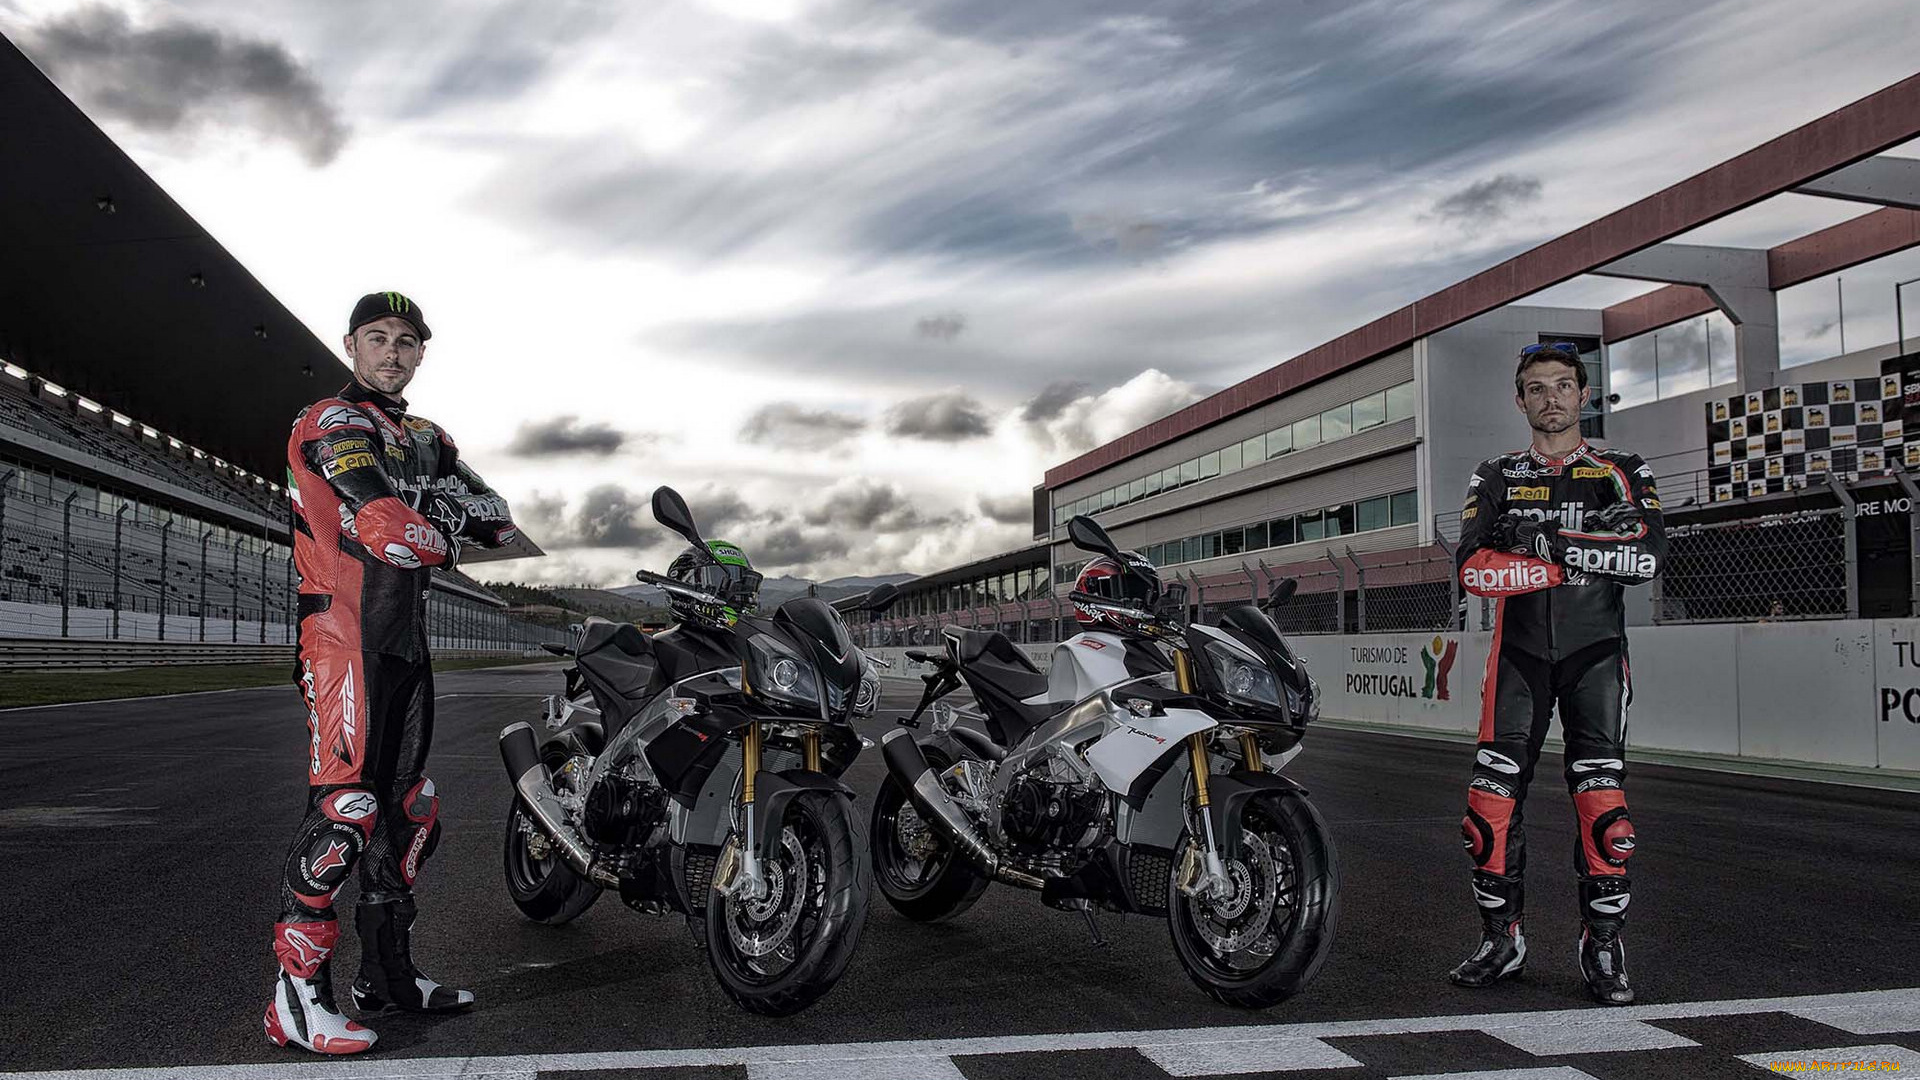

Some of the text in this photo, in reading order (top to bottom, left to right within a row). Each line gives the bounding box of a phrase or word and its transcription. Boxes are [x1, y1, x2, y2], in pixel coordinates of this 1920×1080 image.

[1523, 489, 1547, 499] eni
[1507, 502, 1597, 531] prili
[1565, 545, 1657, 578] aprilia
[1463, 560, 1548, 591] aprilia
[1351, 647, 1408, 664] TURISMO DE
[1346, 673, 1417, 698] PORTUGAL
